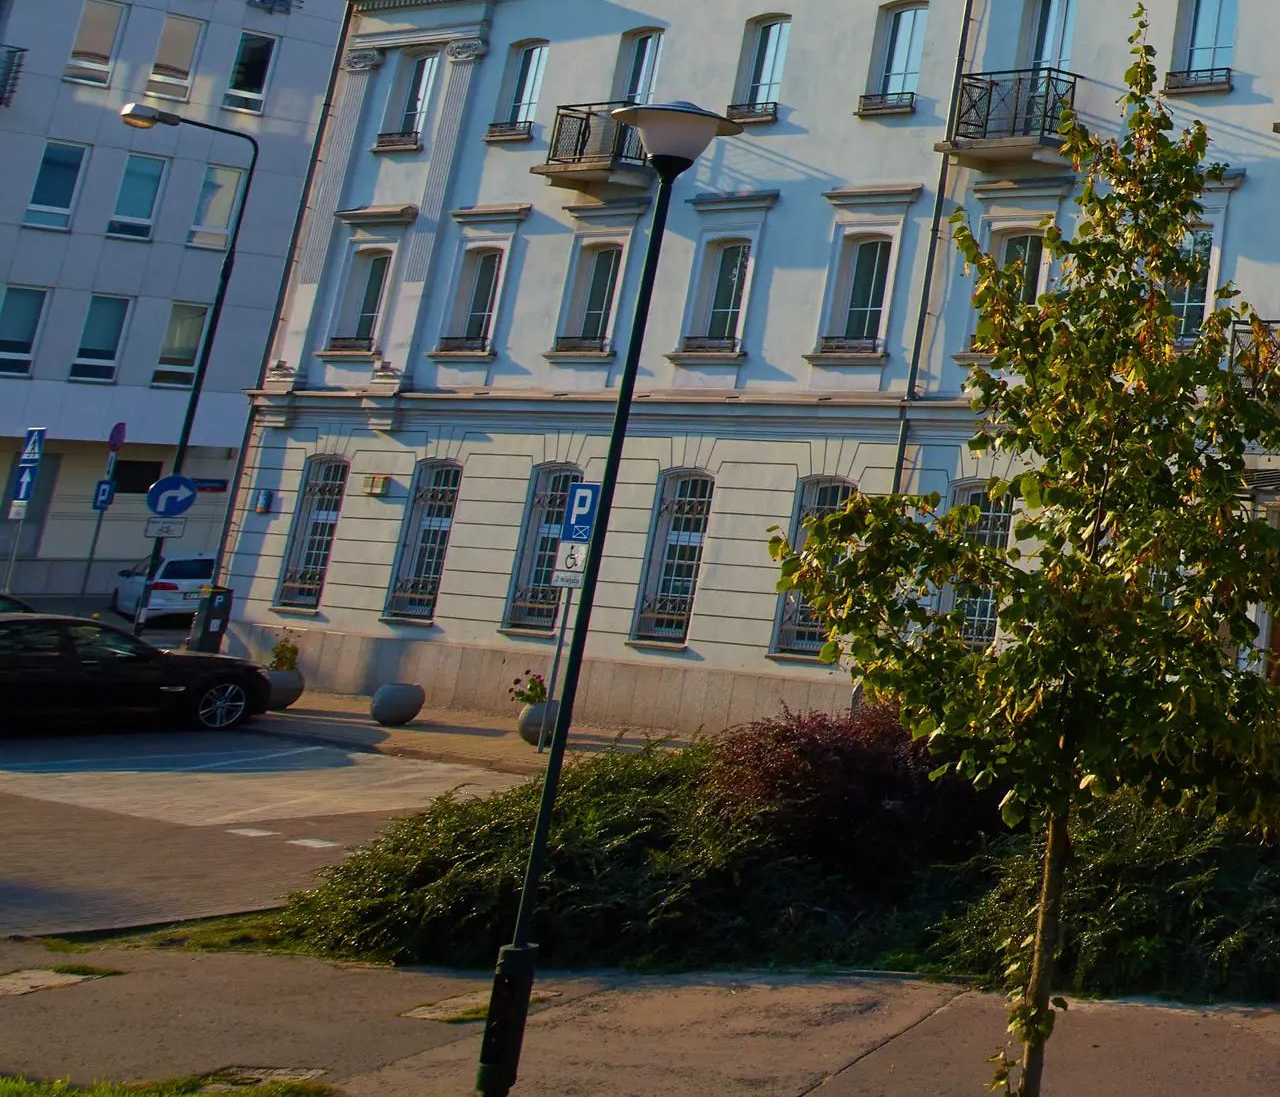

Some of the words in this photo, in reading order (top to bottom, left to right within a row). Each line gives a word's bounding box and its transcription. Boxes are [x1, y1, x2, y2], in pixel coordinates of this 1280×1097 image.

[97, 484, 110, 506] P
[570, 488, 592, 525] P
[214, 595, 224, 607] P
